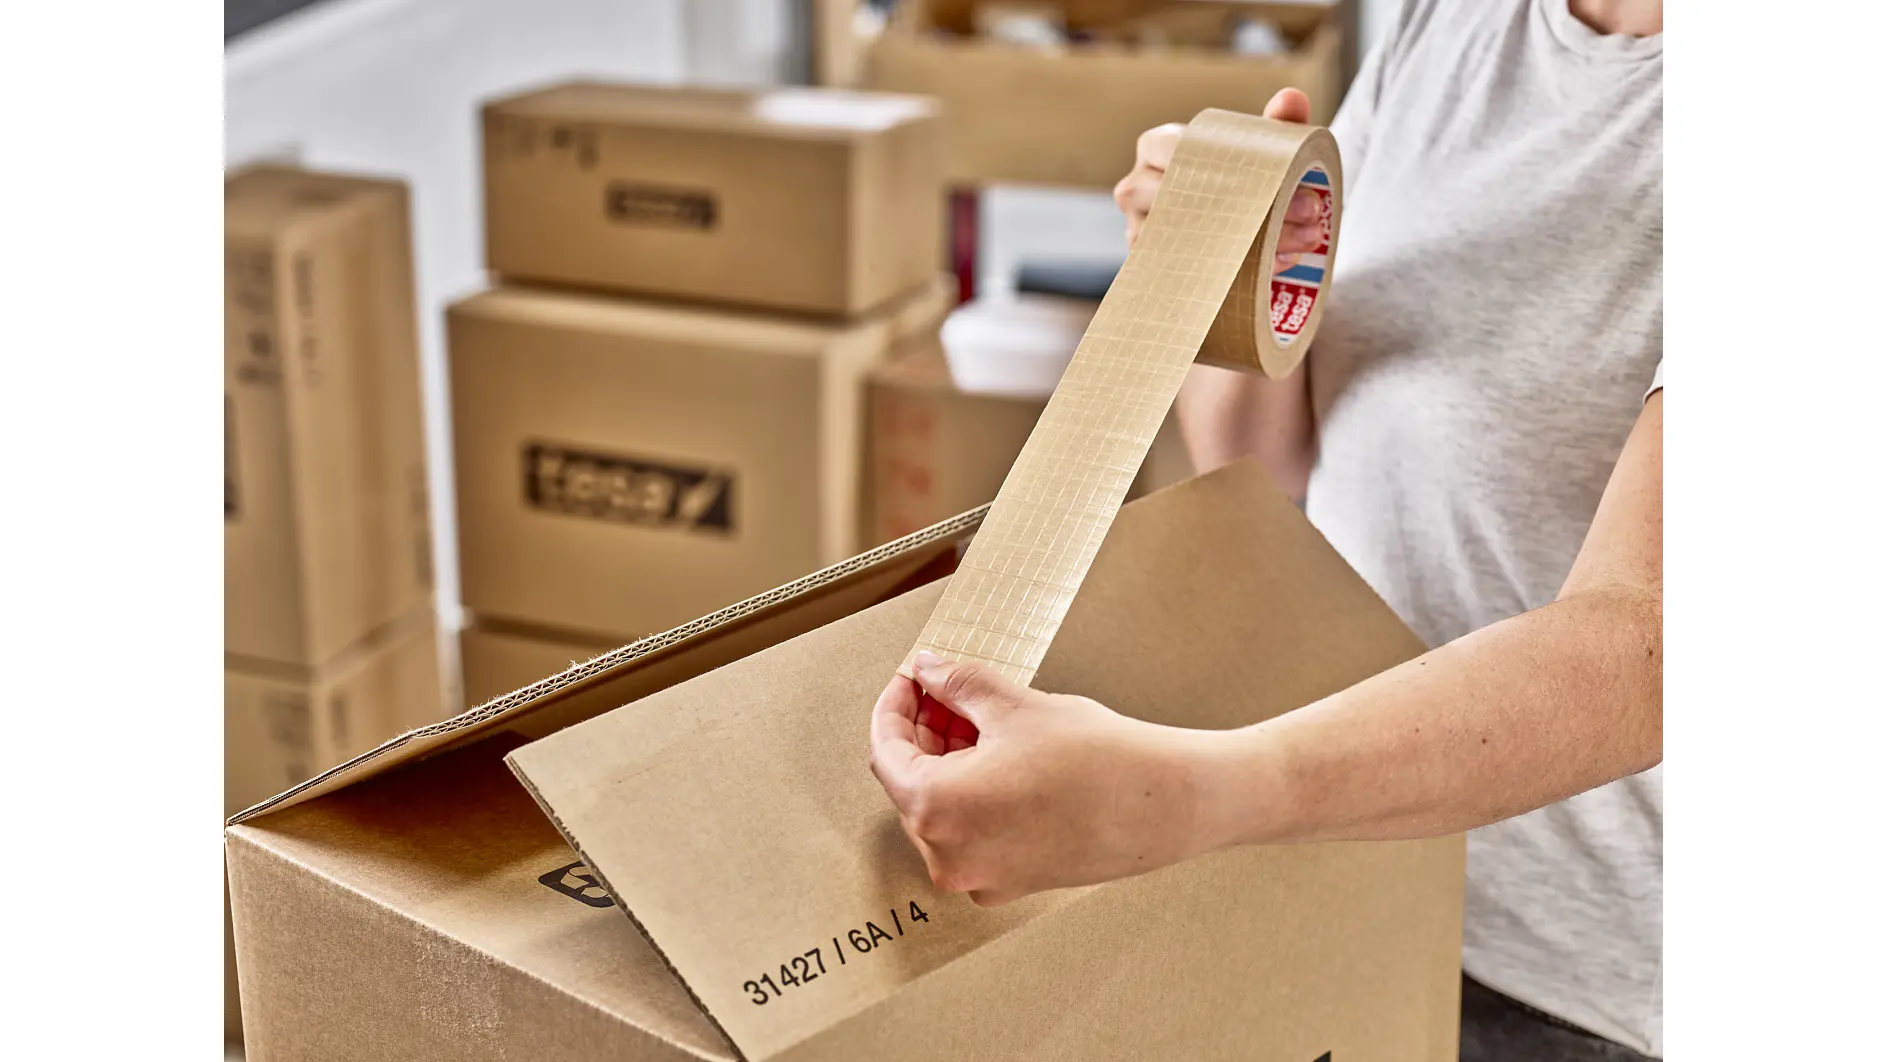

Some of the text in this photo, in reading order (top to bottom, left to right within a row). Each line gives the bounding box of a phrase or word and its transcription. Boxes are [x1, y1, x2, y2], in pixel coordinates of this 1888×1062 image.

[1269, 290, 1294, 328] esa
[743, 900, 929, 1005] 31427 / 6A / 4
